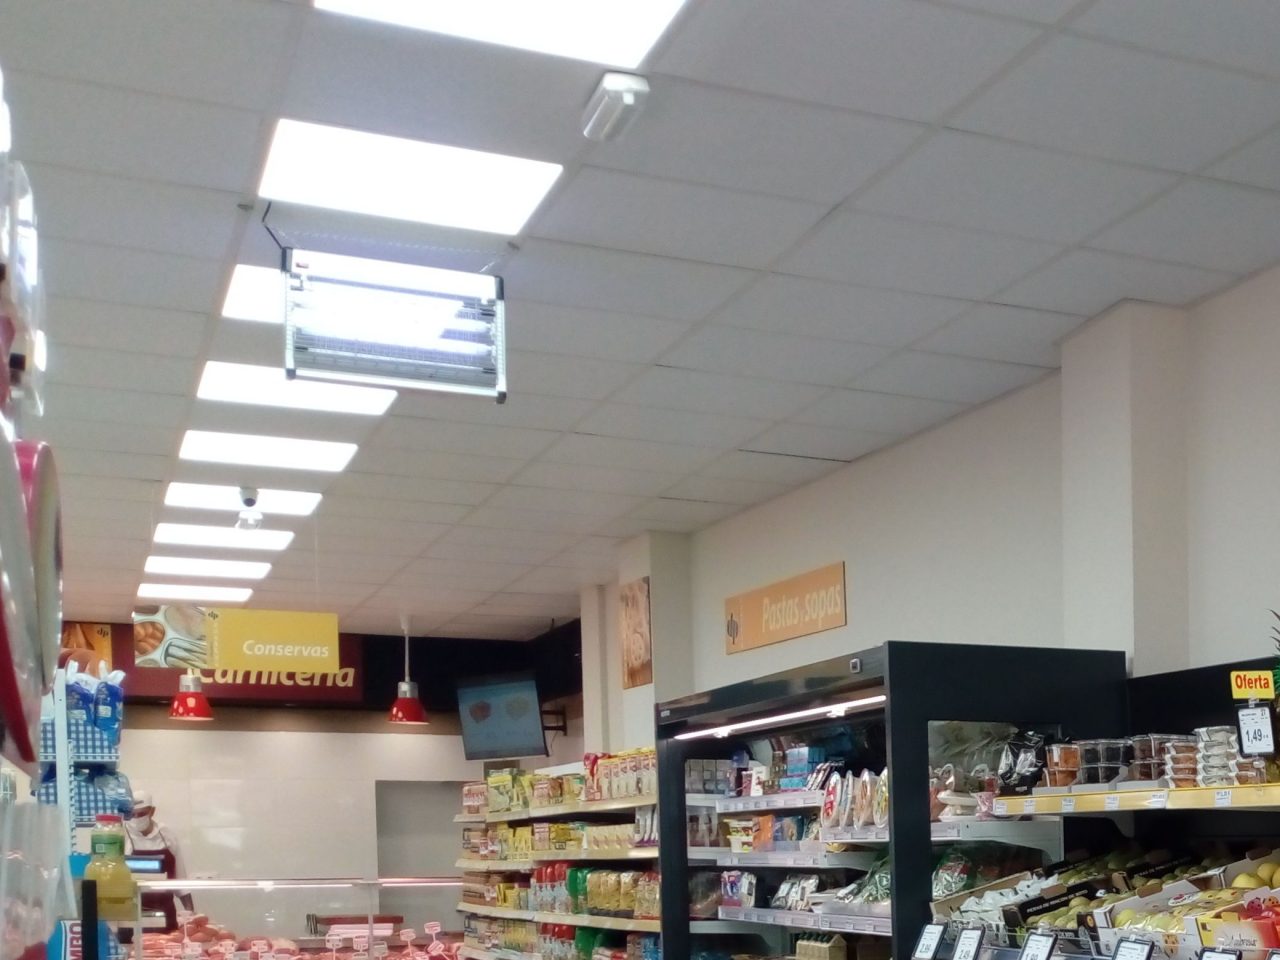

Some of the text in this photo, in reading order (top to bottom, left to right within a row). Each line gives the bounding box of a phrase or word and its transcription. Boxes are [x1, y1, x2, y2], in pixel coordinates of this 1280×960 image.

[805, 585, 840, 628] sopas
[242, 639, 330, 658] Conservas
[1235, 673, 1270, 690] Oferta
[1245, 727, 1263, 745] 1,49
